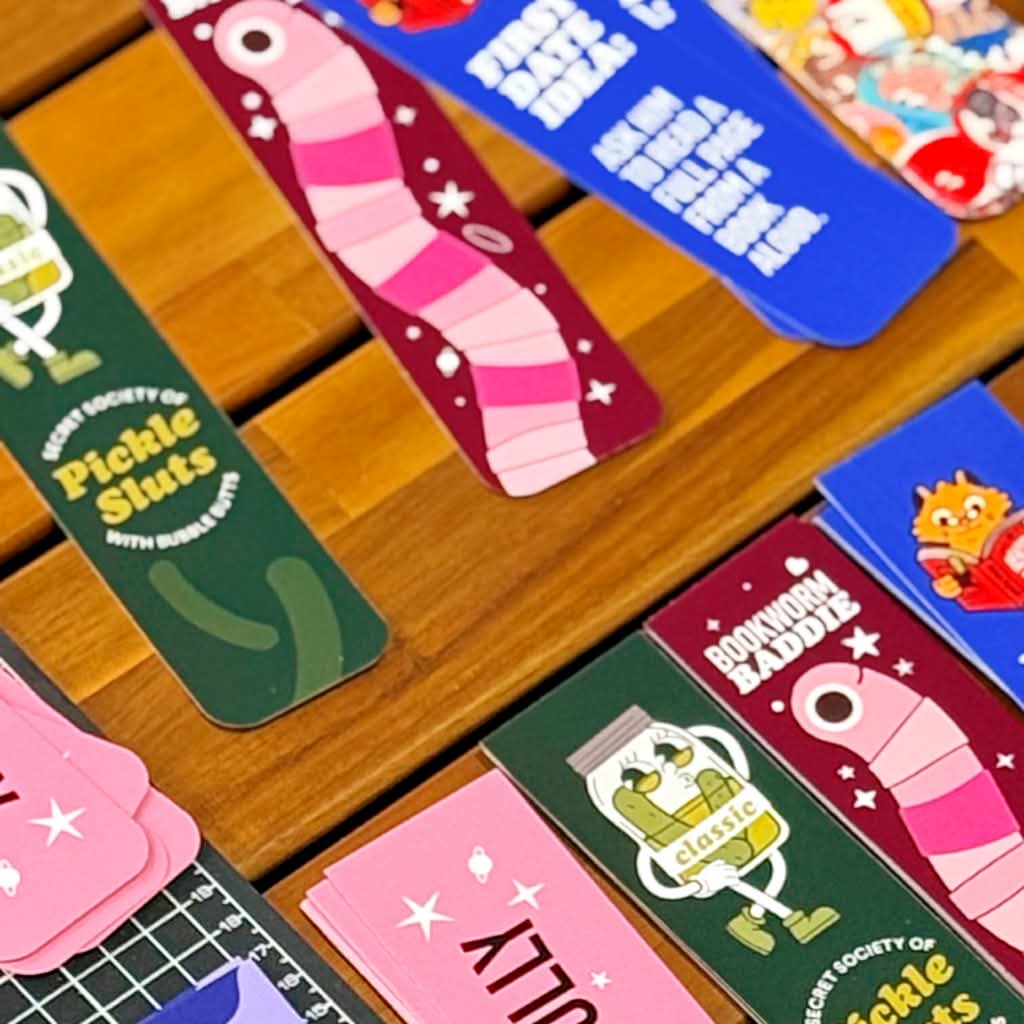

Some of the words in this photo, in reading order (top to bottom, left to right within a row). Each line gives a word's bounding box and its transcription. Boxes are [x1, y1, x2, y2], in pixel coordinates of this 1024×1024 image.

[52, 407, 200, 501] Pickle
[96, 445, 217, 524] Sluts
[105, 529, 154, 550] WITH
[703, 569, 840, 675] BOOKWORM
[726, 590, 861, 696] BADDIE
[674, 801, 757, 866] classic
[832, 937, 905, 974] SOCIETY
[908, 936, 937, 952] OF
